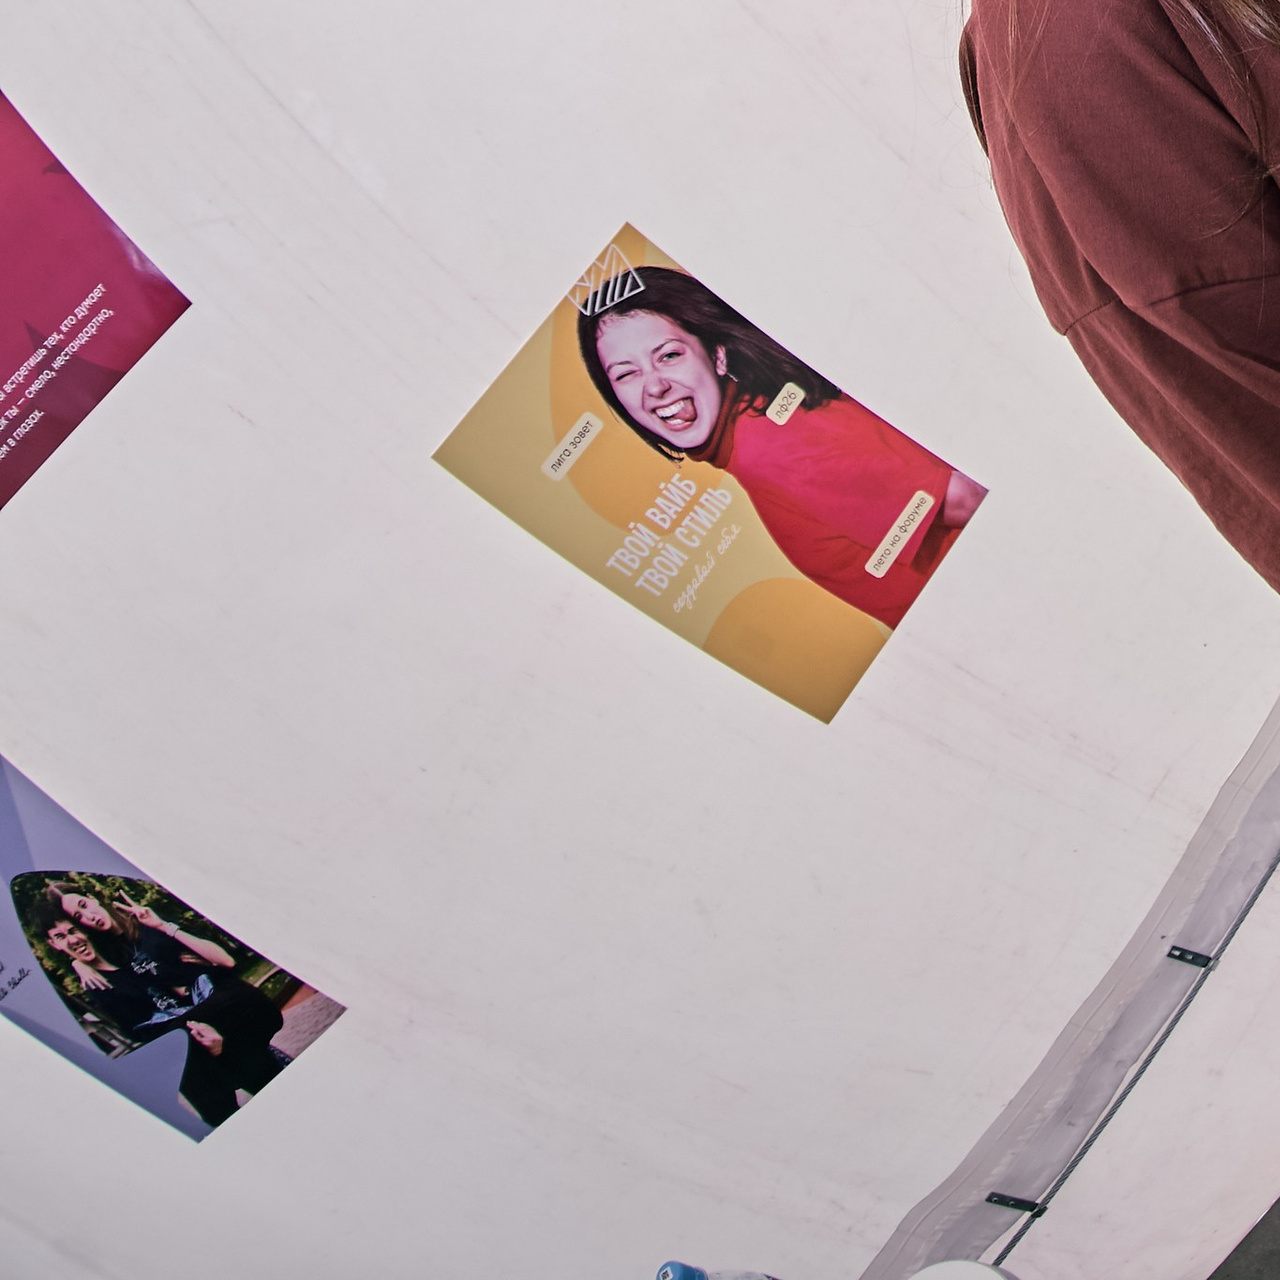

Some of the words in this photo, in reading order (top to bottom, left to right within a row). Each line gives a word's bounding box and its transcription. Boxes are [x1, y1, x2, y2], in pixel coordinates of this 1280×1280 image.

[3, 346, 48, 394] встретишь
[43, 328, 65, 352] тех,
[60, 313, 77, 333] кто
[75, 282, 107, 320] думает
[7, 403, 20, 420] ты
[25, 367, 57, 400] смело,
[52, 307, 115, 370] нестандартно,
[8, 436, 17, 449] в
[550, 446, 572, 473] лига
[569, 420, 594, 450] зовет
[774, 389, 797, 420] лф26
[606, 520, 658, 578] ТВОЙ
[645, 473, 697, 531] ВАЙБ
[635, 542, 684, 597] ТВОЙ
[674, 486, 733, 552] СТИЛЬ
[672, 551, 716, 614] создавай
[717, 524, 742, 557] себя
[872, 546, 891, 572] лето
[888, 531, 901, 549] на
[897, 495, 928, 537] форуме
